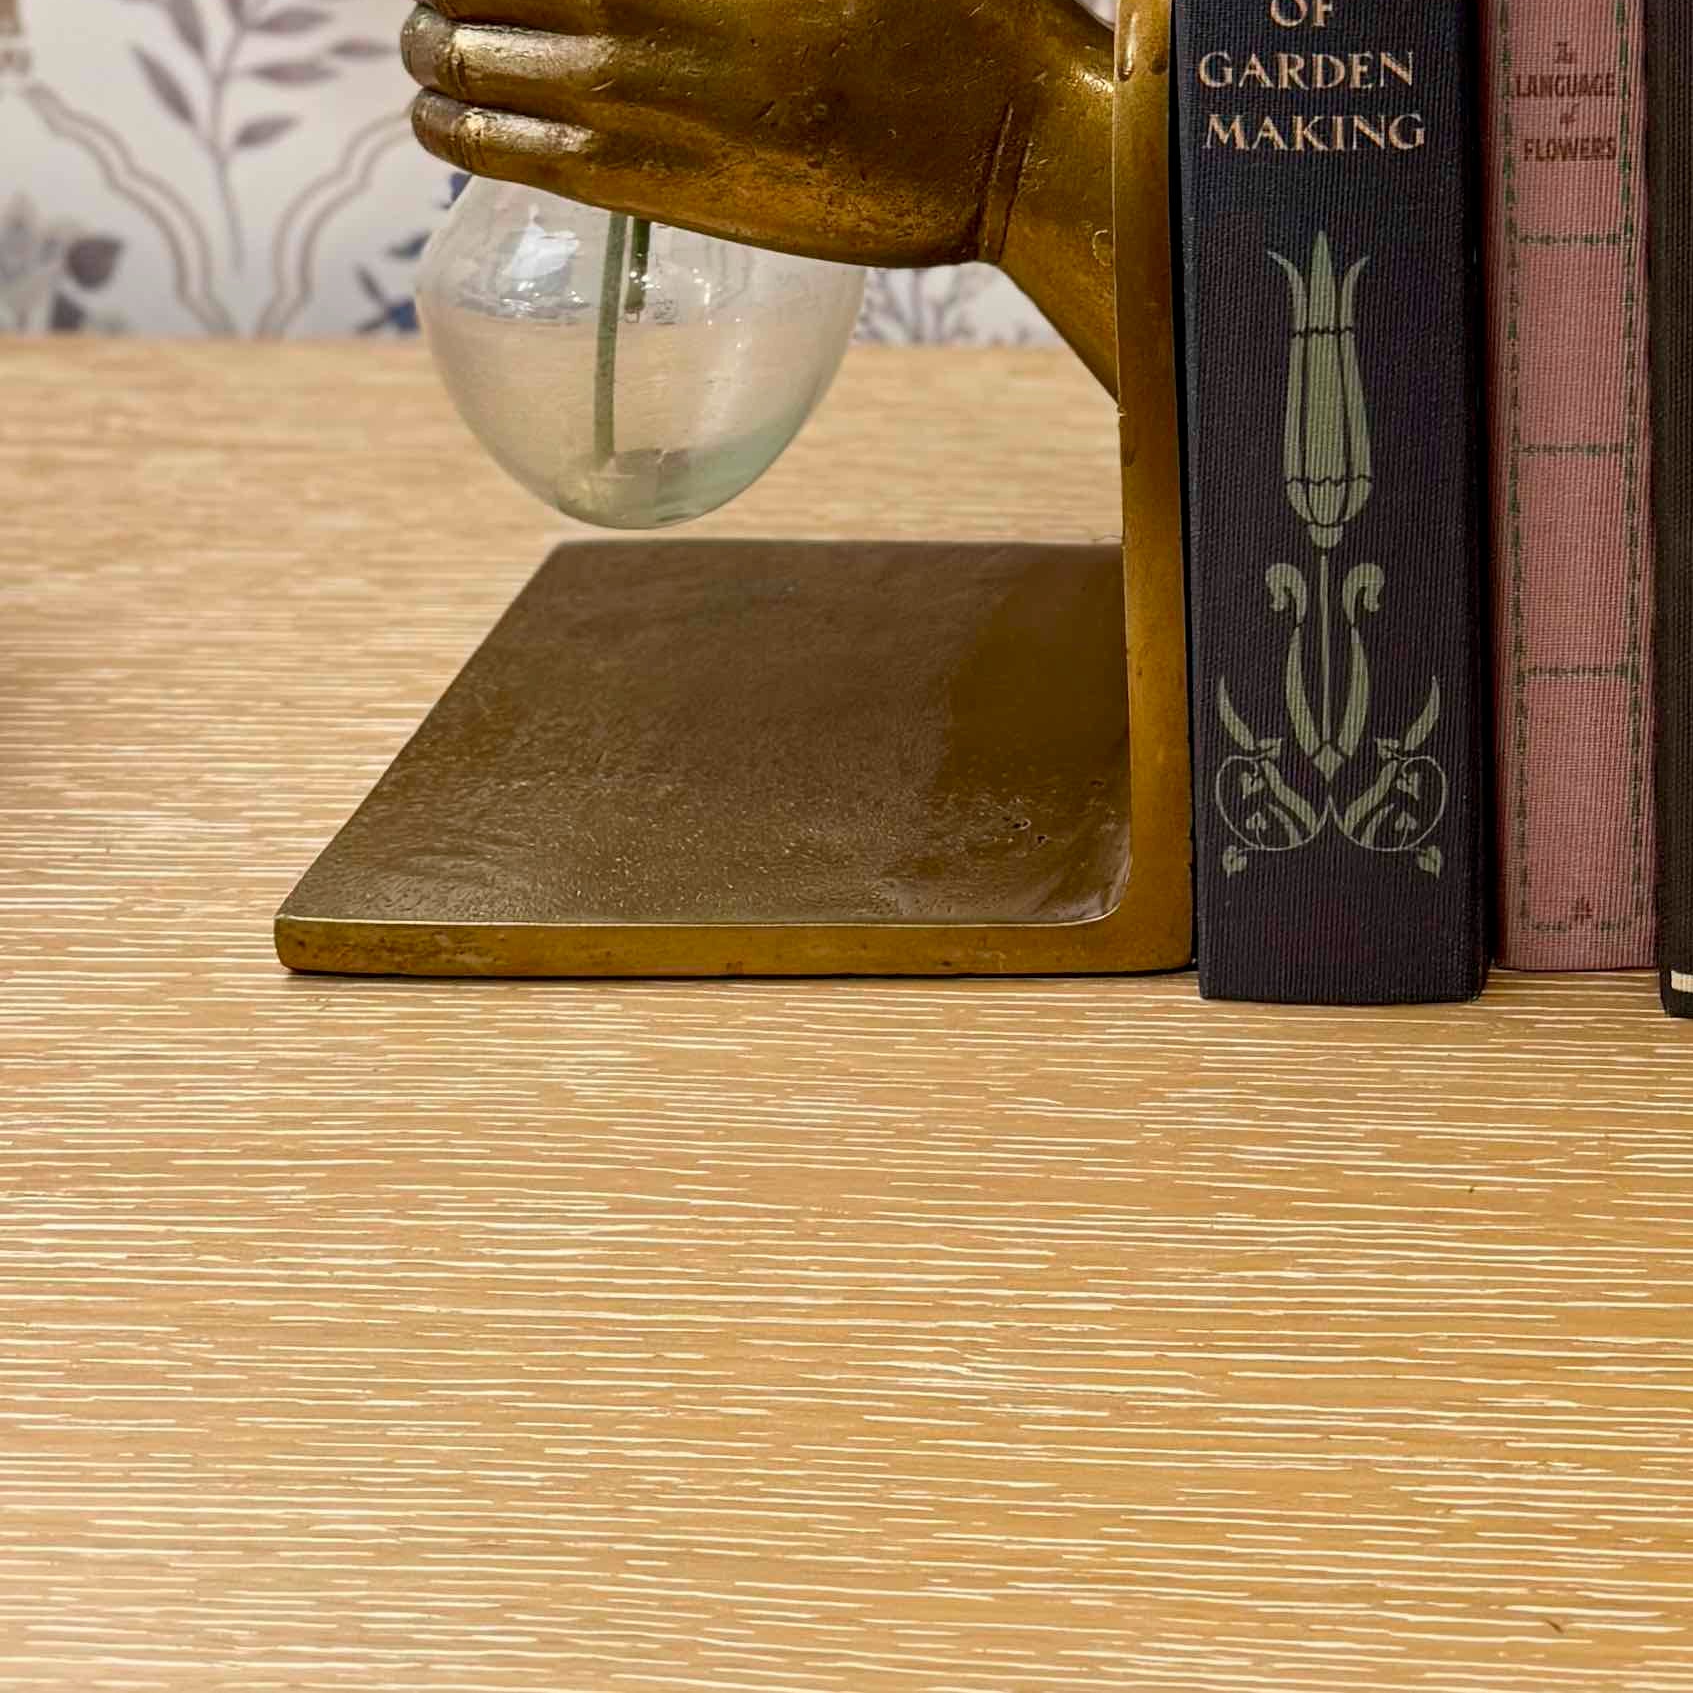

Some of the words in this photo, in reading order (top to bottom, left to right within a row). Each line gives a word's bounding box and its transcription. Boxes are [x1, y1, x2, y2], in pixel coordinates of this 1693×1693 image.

[1199, 50, 1415, 91] GARDEN
[1514, 73, 1616, 99] LANGUAGE
[1203, 113, 1426, 152] MAKING
[1522, 137, 1618, 163] FLOWERS
